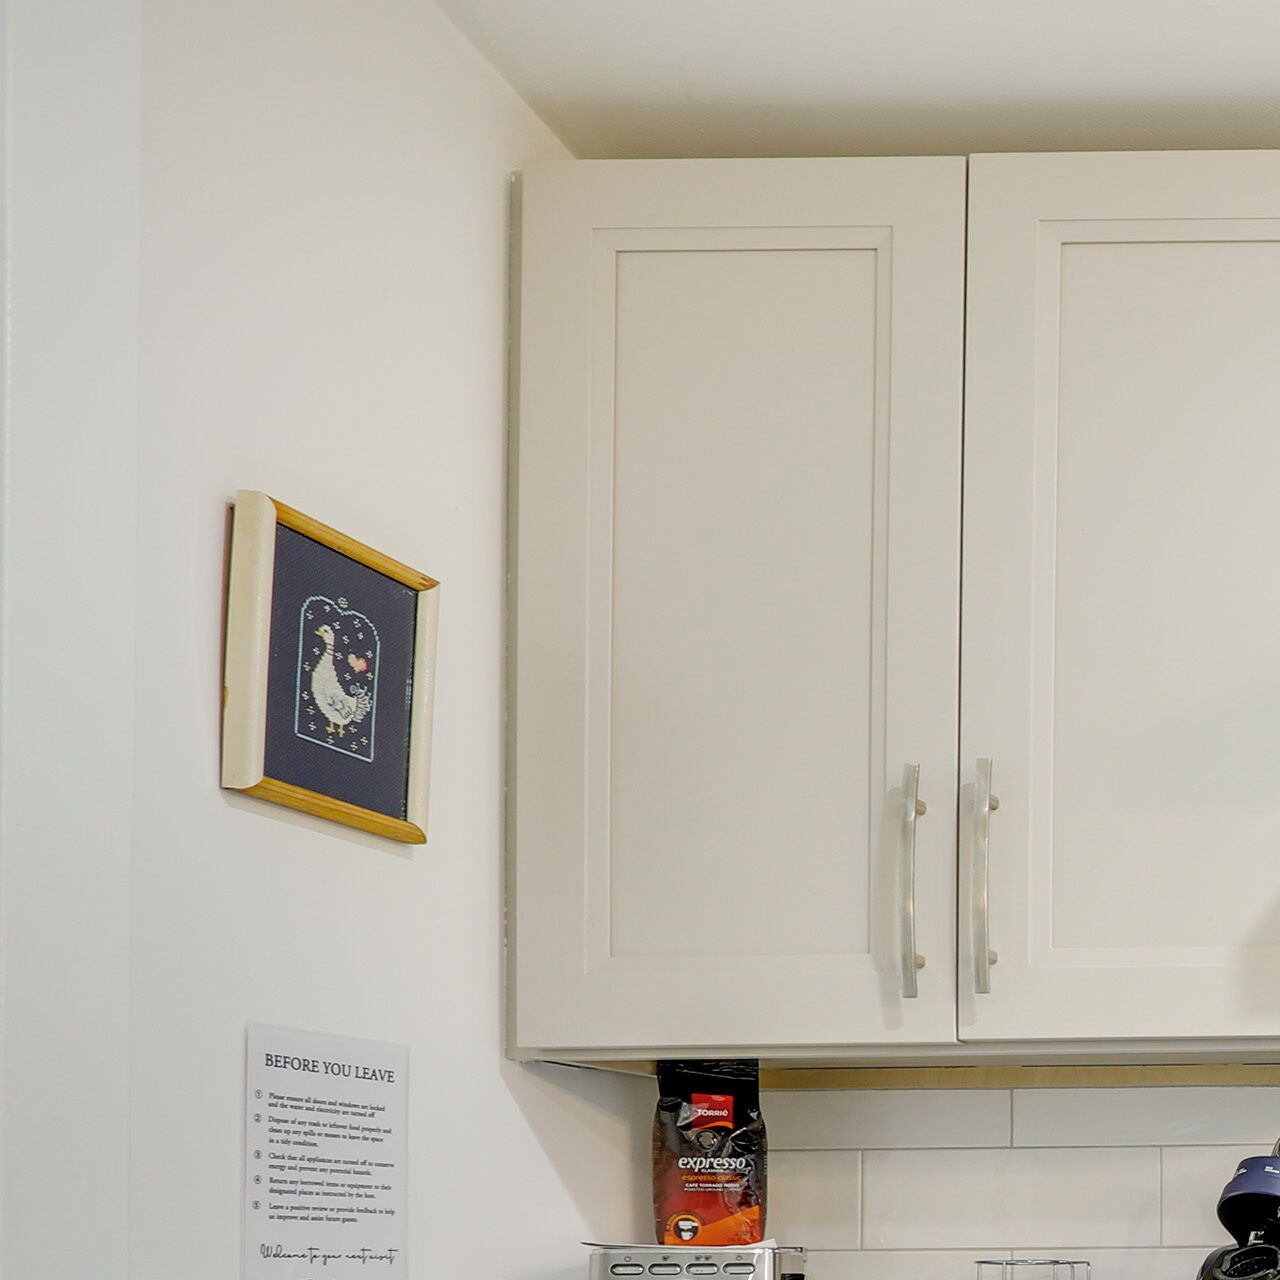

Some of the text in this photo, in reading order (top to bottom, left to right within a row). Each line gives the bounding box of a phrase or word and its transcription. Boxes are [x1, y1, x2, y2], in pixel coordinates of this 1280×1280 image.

[265, 1053, 395, 1083] BEFORE YOU LEAVE
[677, 1156, 746, 1172] expresso
